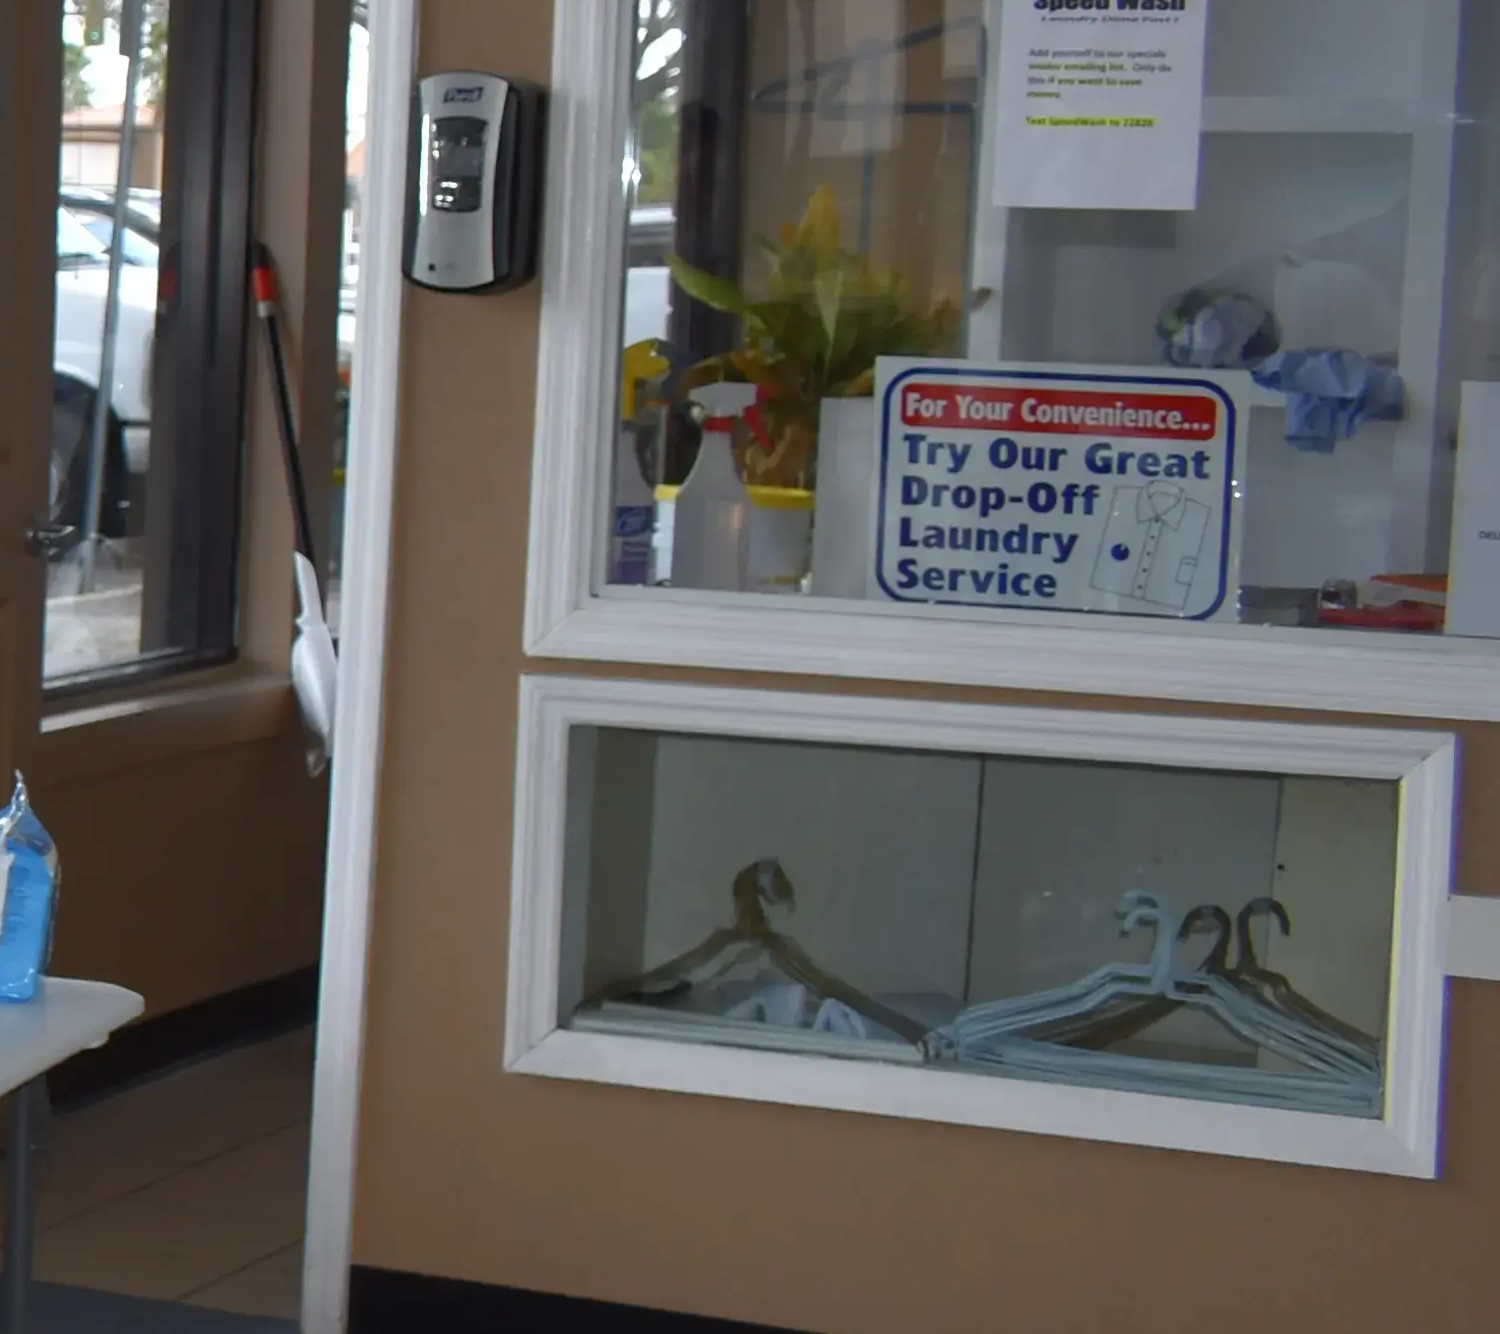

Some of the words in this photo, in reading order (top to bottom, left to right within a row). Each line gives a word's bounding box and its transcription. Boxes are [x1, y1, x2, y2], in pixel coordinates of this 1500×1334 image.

[905, 392, 947, 418] For
[955, 394, 1014, 422] Your
[1020, 397, 1211, 431] Convenience...
[902, 433, 972, 474] Try
[988, 437, 1068, 472] Our
[1083, 442, 1211, 480] Great
[901, 474, 1101, 518] Drop-Off
[899, 516, 1080, 564] Laundry
[895, 558, 1057, 598] Service
